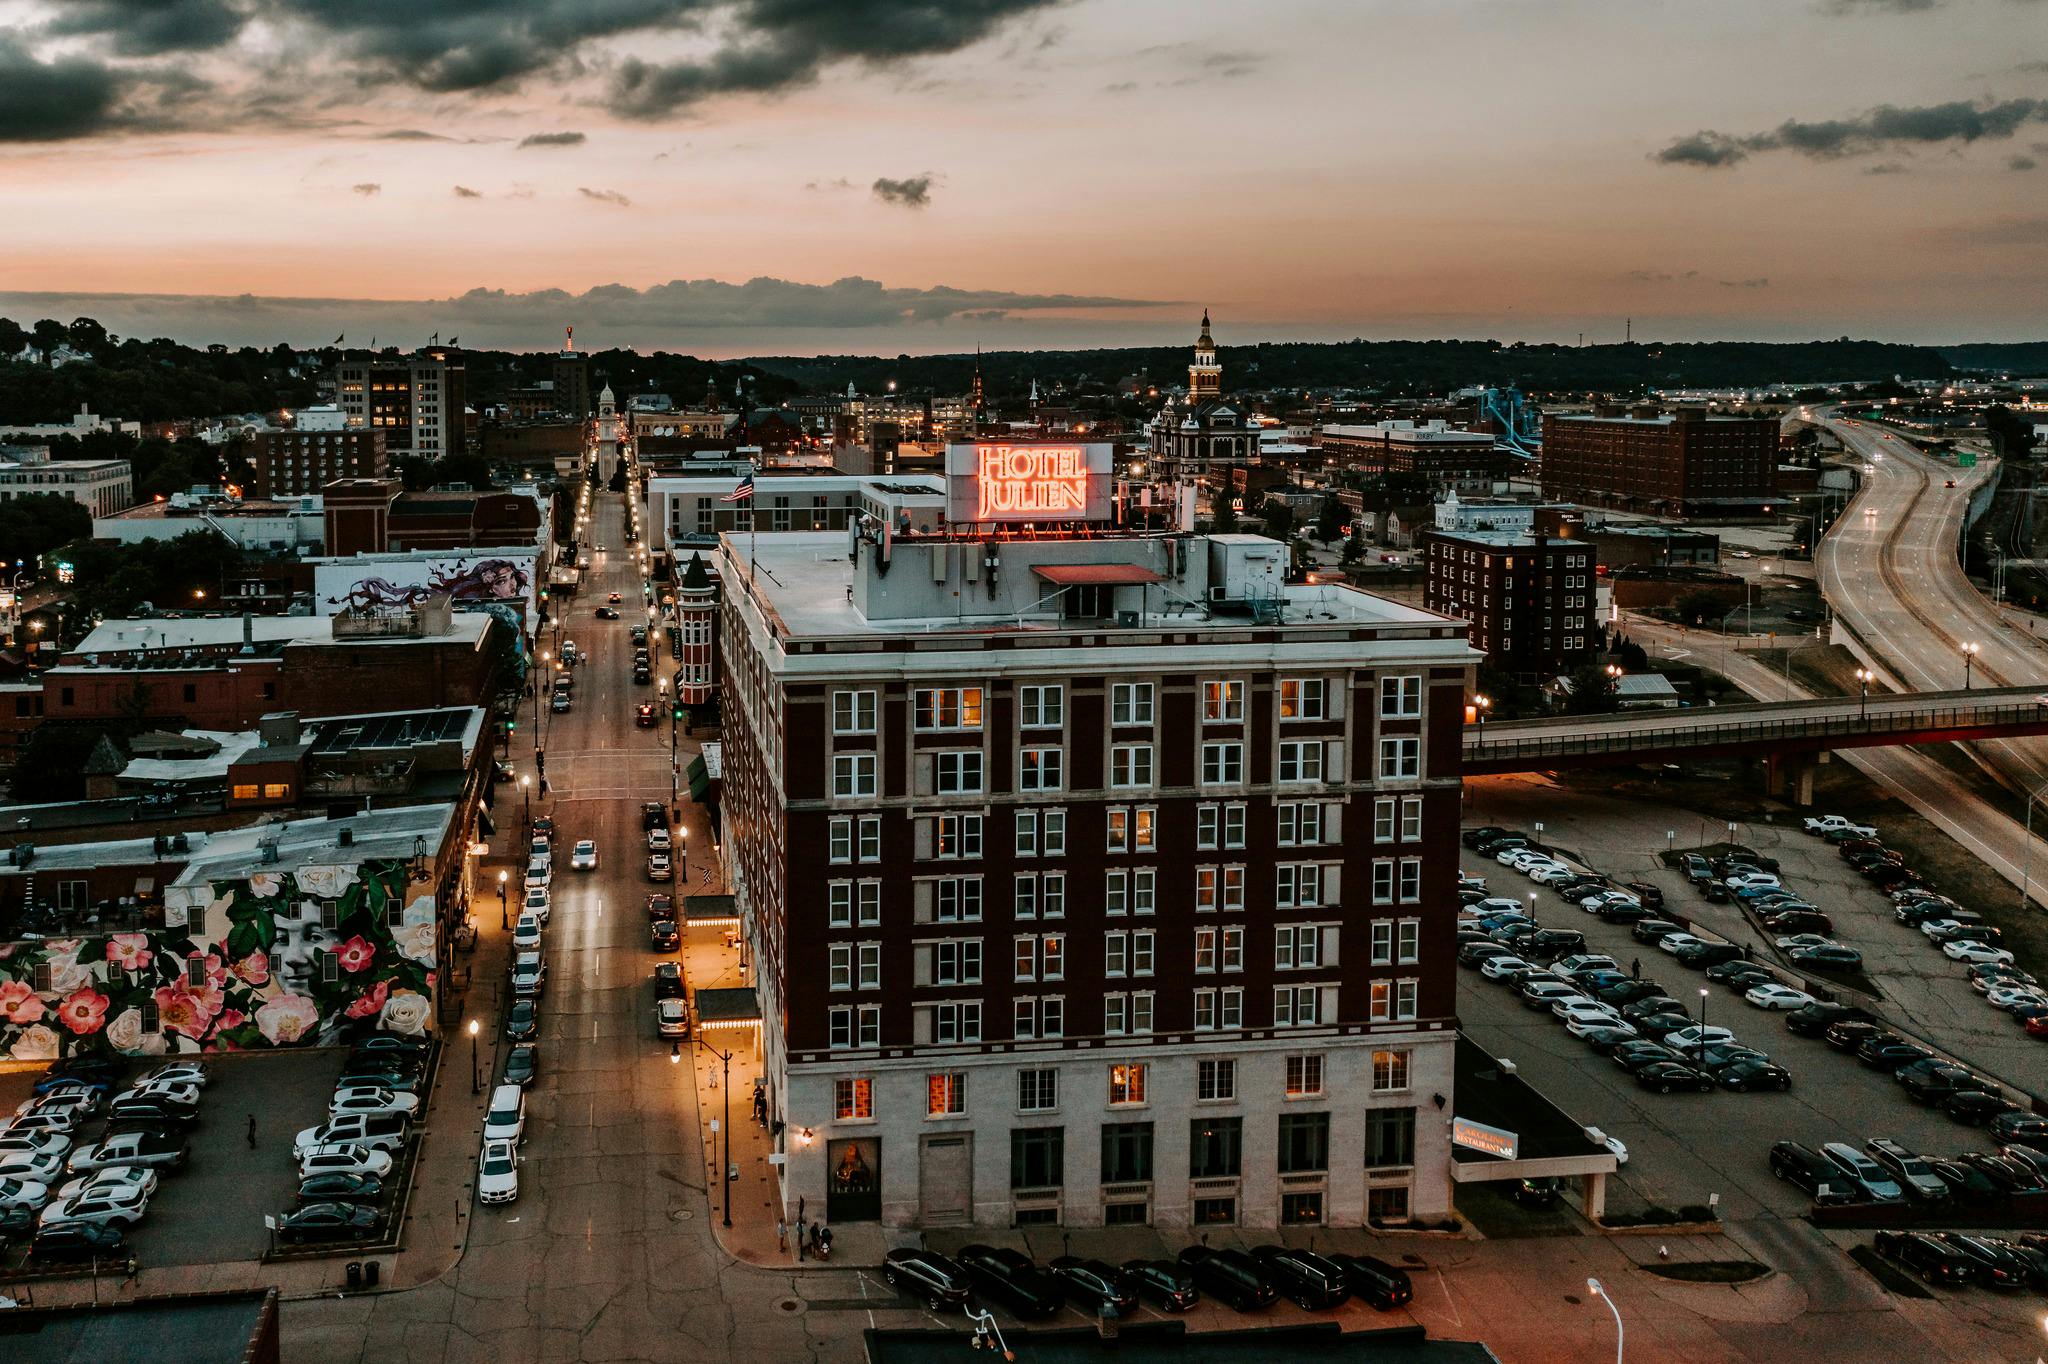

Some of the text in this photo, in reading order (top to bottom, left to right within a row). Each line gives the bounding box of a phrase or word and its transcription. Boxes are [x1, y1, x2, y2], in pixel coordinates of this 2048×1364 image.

[978, 446, 1087, 479] HOTEL
[978, 479, 1087, 518] JULIEN
[1456, 1135, 1500, 1153] RESTAURANT
